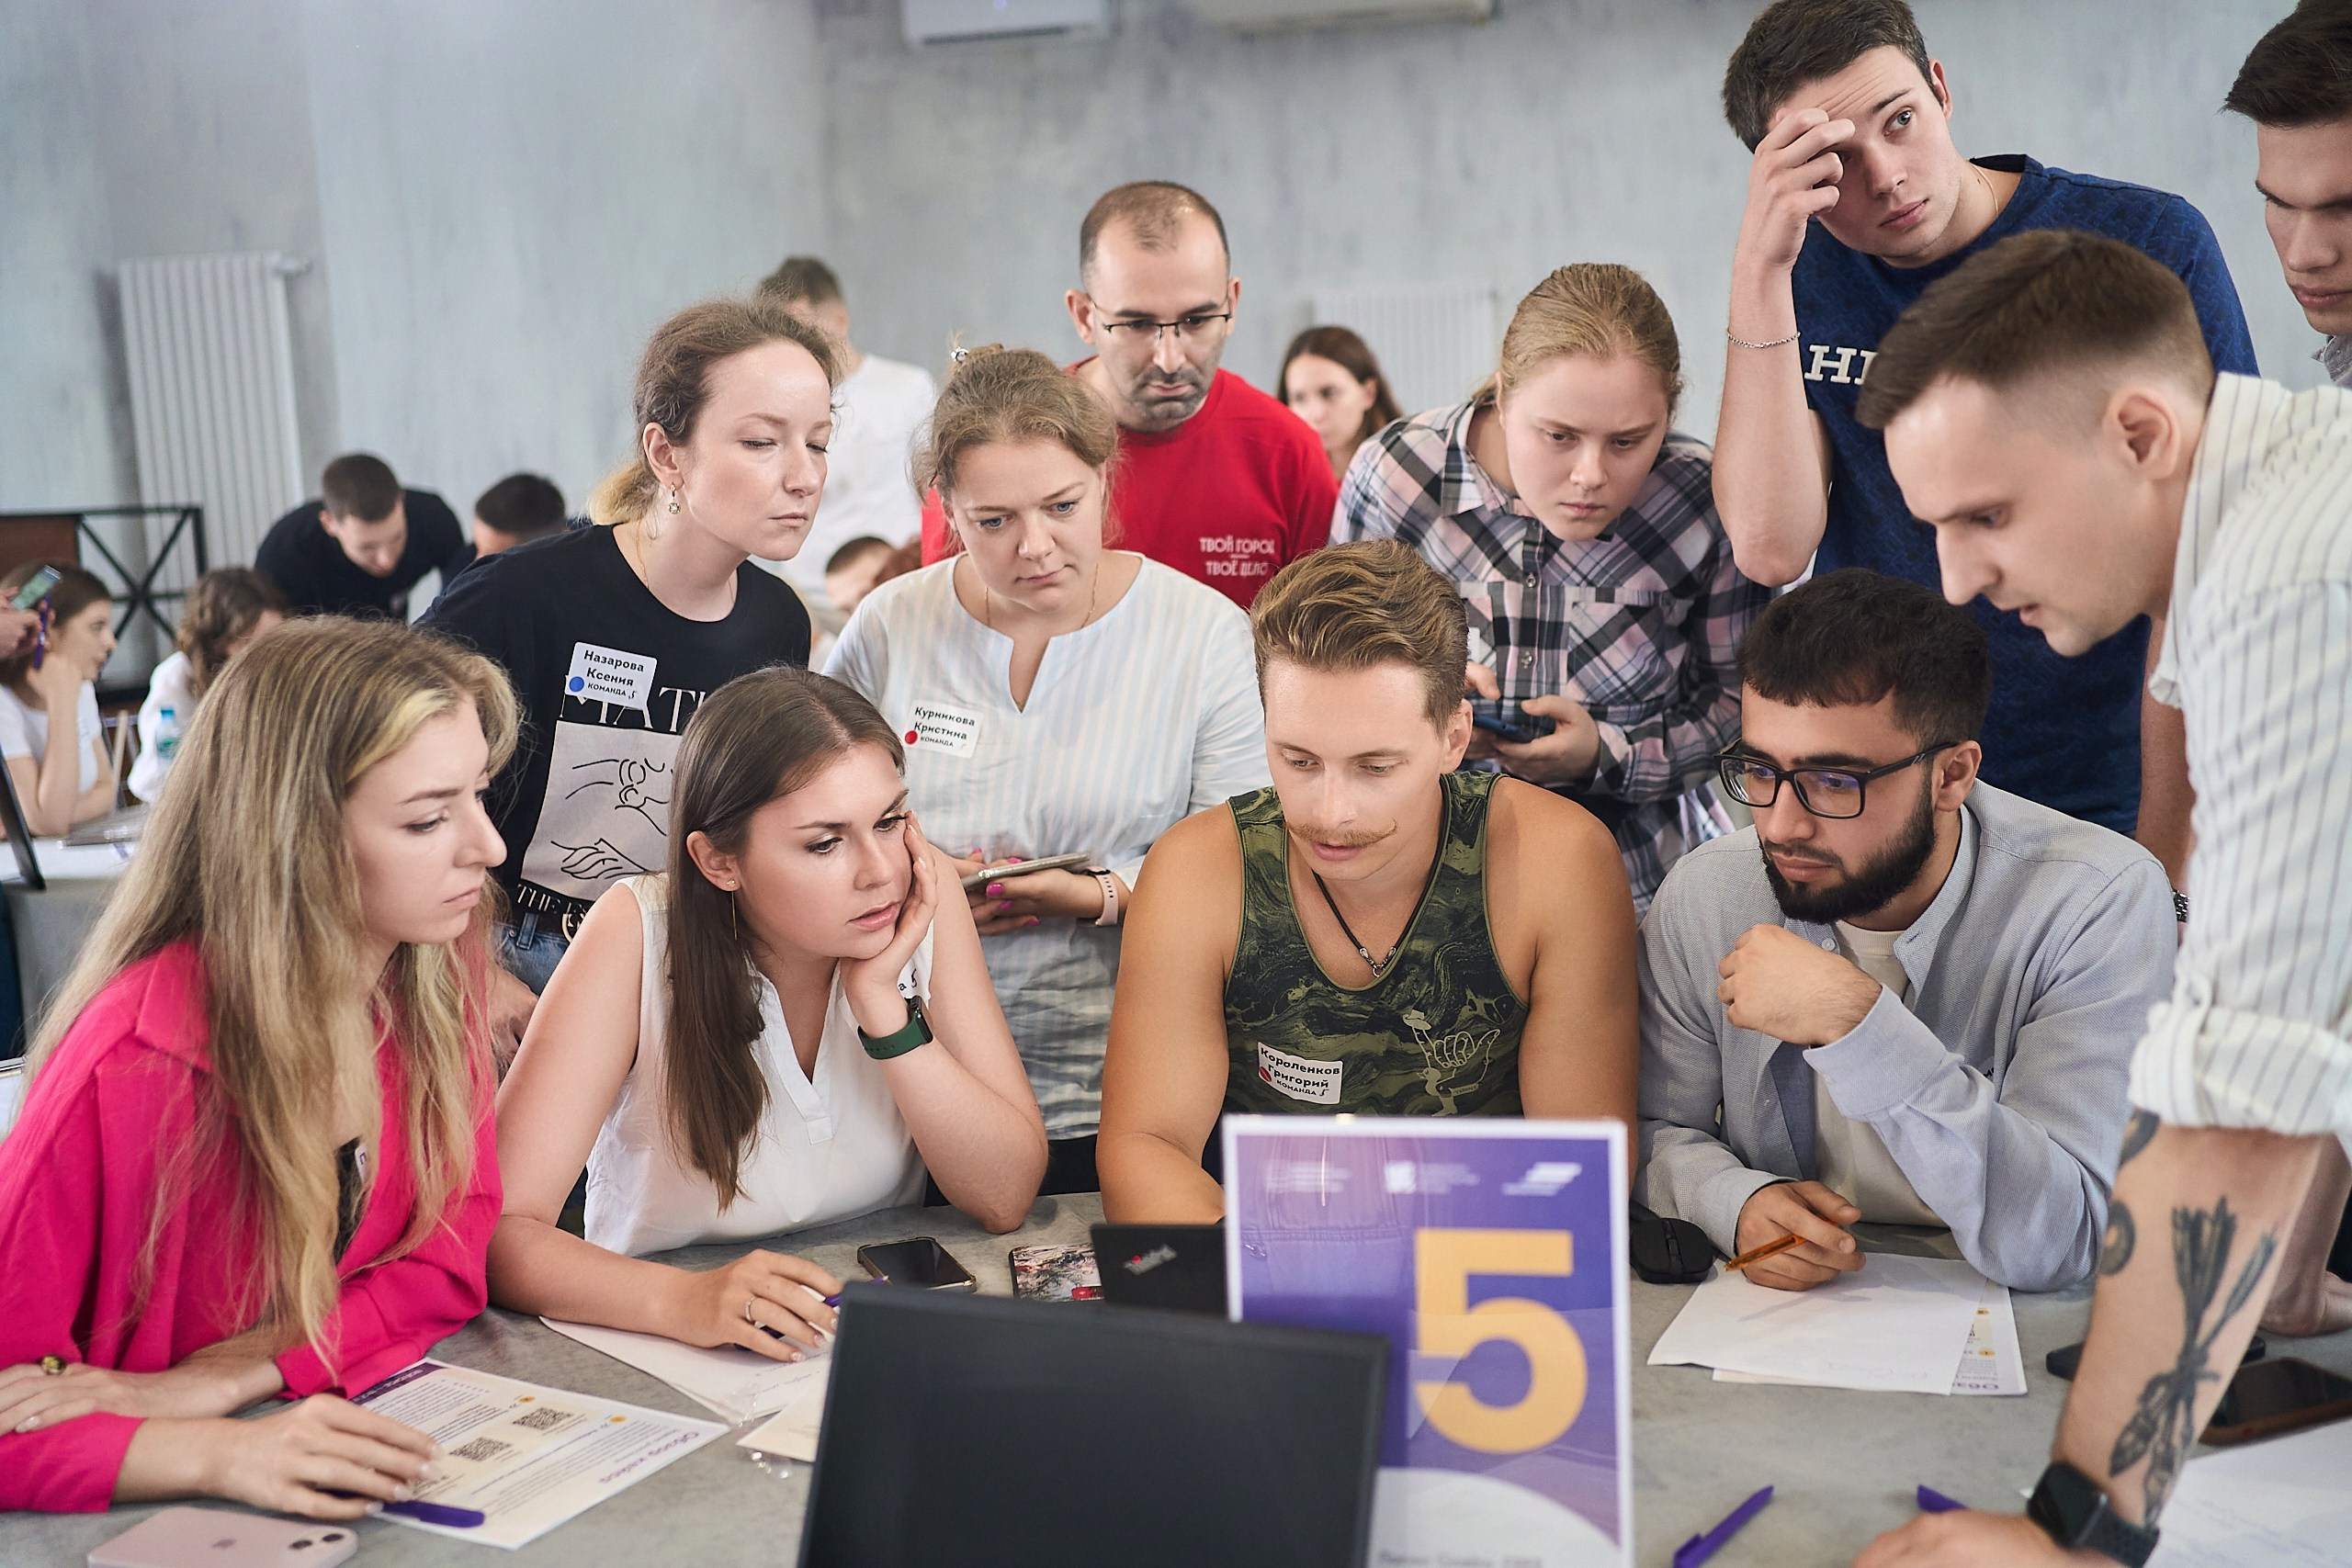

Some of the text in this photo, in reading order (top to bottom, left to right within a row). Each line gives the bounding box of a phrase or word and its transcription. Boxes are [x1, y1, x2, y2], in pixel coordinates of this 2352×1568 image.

[1199, 535, 1235, 553] ТВОЙ
[583, 649, 644, 672] Назарова
[586, 667, 634, 687] Ксения
[588, 682, 627, 696] КОМАНДА
[914, 706, 976, 727] Курникова
[913, 721, 967, 740] Кристина
[920, 736, 954, 747] КОМАНДА
[1261, 1047, 1340, 1075] Короленков
[1268, 1064, 1329, 1089] Григорий
[1276, 1079, 1317, 1096] КОМАНДА
[1414, 1228, 1588, 1454] 5
